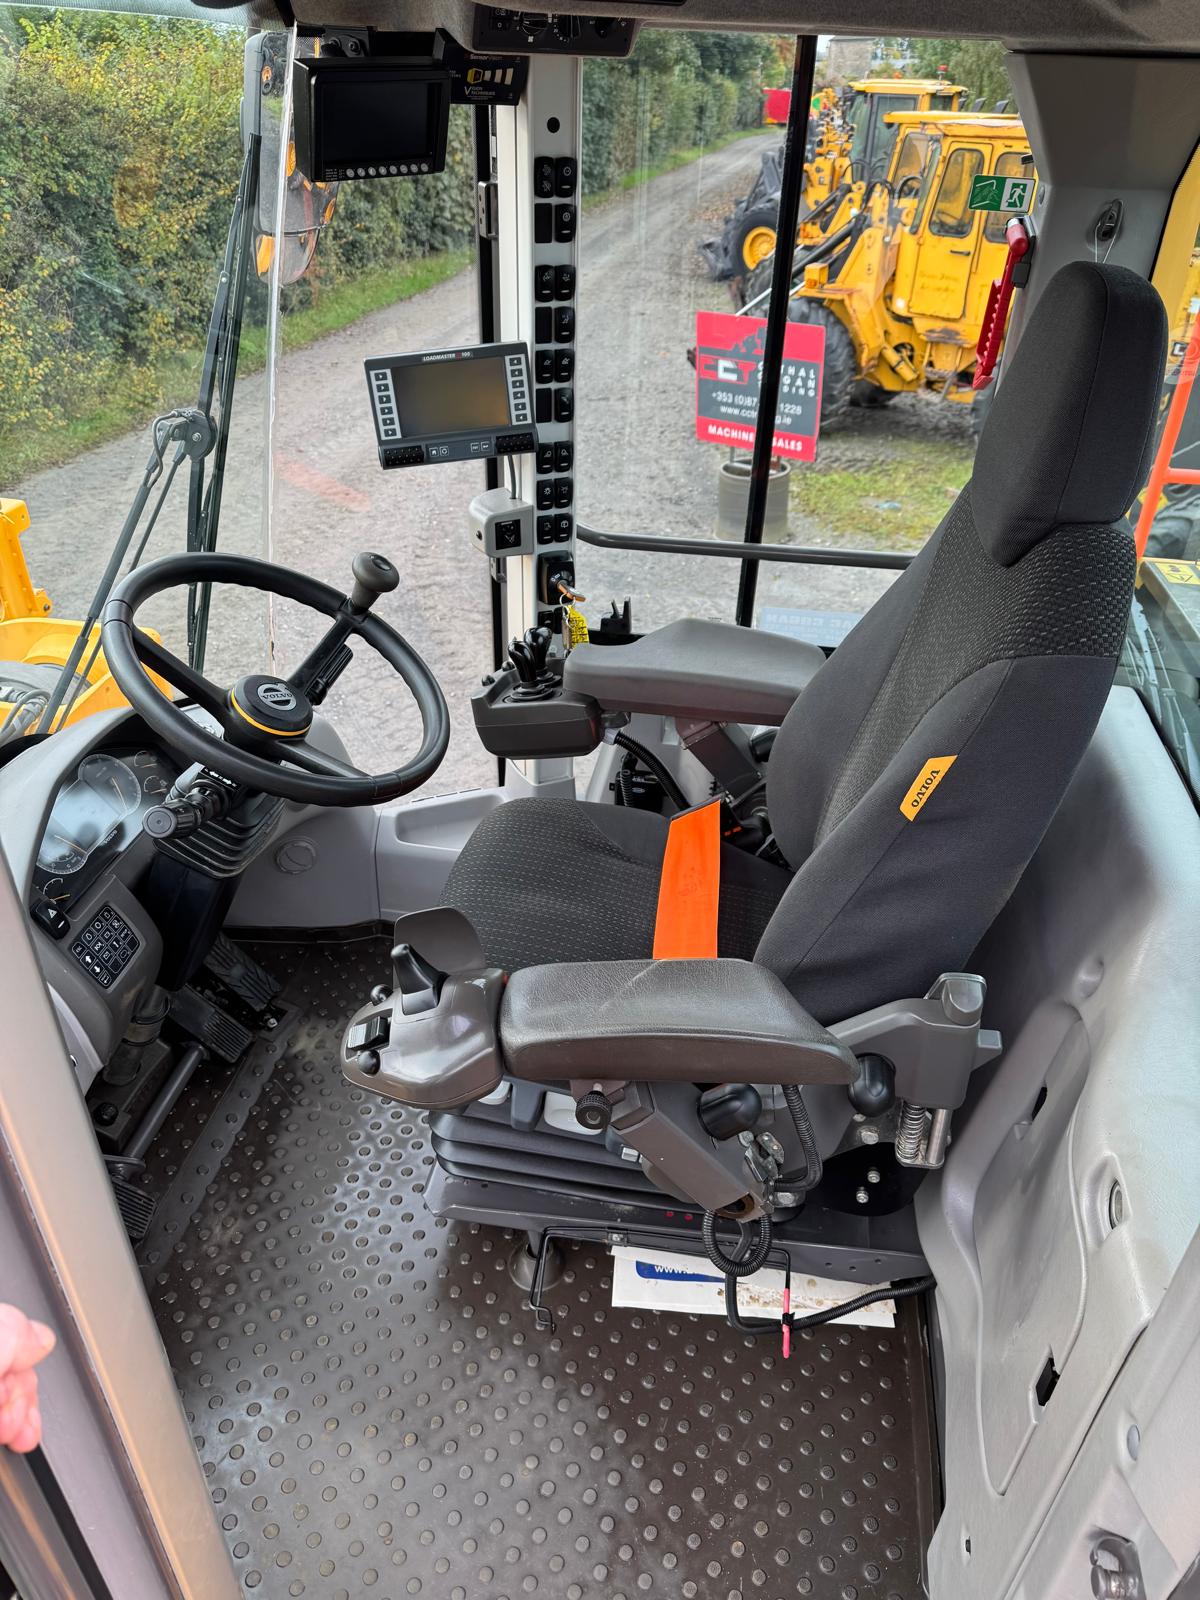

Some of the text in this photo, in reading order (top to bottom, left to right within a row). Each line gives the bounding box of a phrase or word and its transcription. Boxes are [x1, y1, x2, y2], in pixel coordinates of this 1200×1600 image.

[423, 353, 456, 362] LOADMASTER
[699, 357, 758, 384] CCT
[712, 390, 733, 403] +353
[772, 435, 803, 452] SALES
[261, 692, 293, 700] VOLVO
[911, 769, 941, 808] VOLVO
